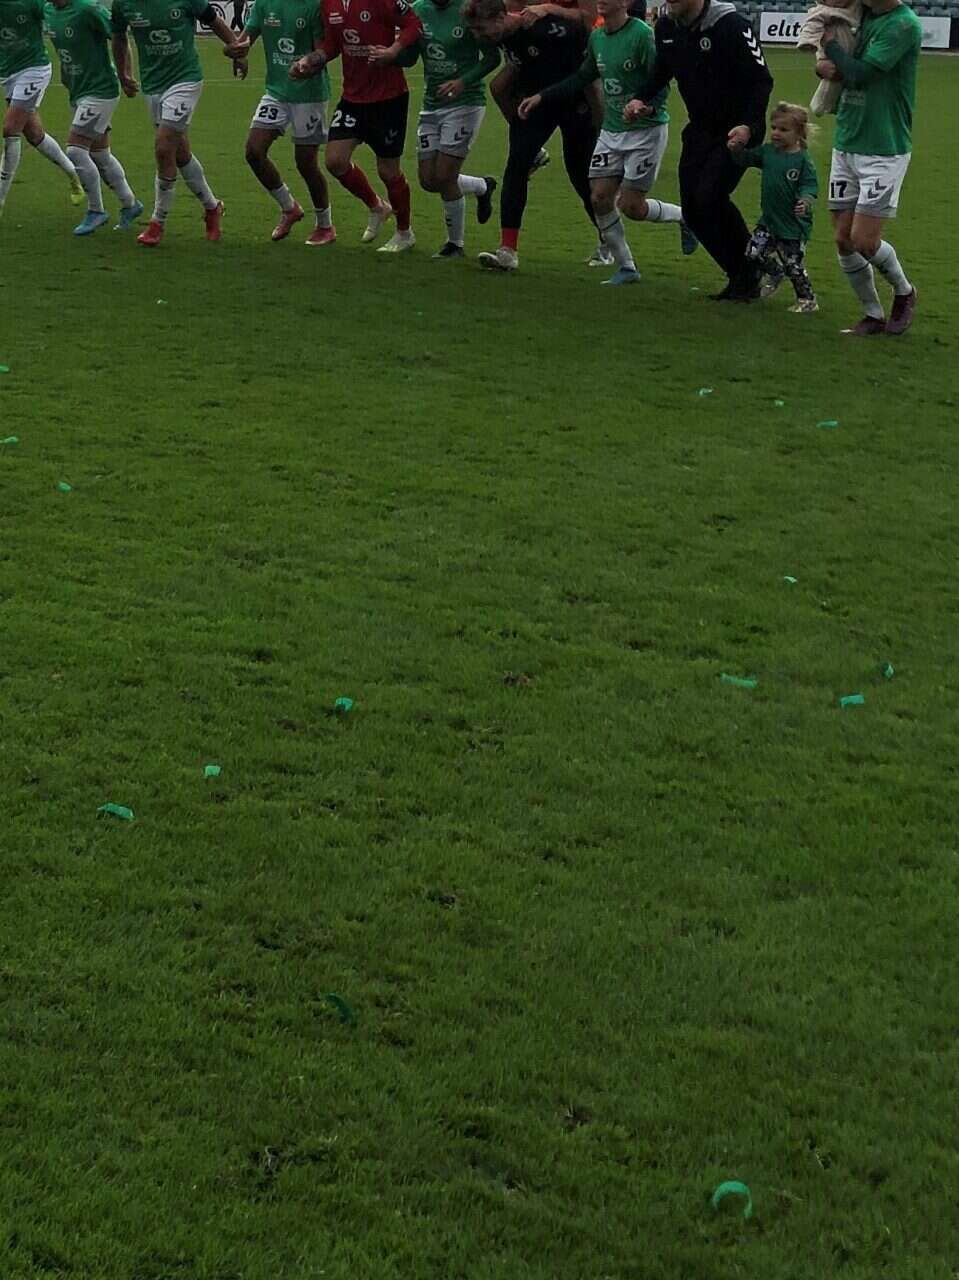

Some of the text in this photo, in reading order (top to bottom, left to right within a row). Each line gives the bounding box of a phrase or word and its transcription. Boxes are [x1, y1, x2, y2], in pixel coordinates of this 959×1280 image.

[767, 19, 801, 37] elit
[257, 104, 279, 121] 23
[331, 109, 357, 129] 25
[591, 153, 610, 169] 21
[830, 181, 848, 200] 17
